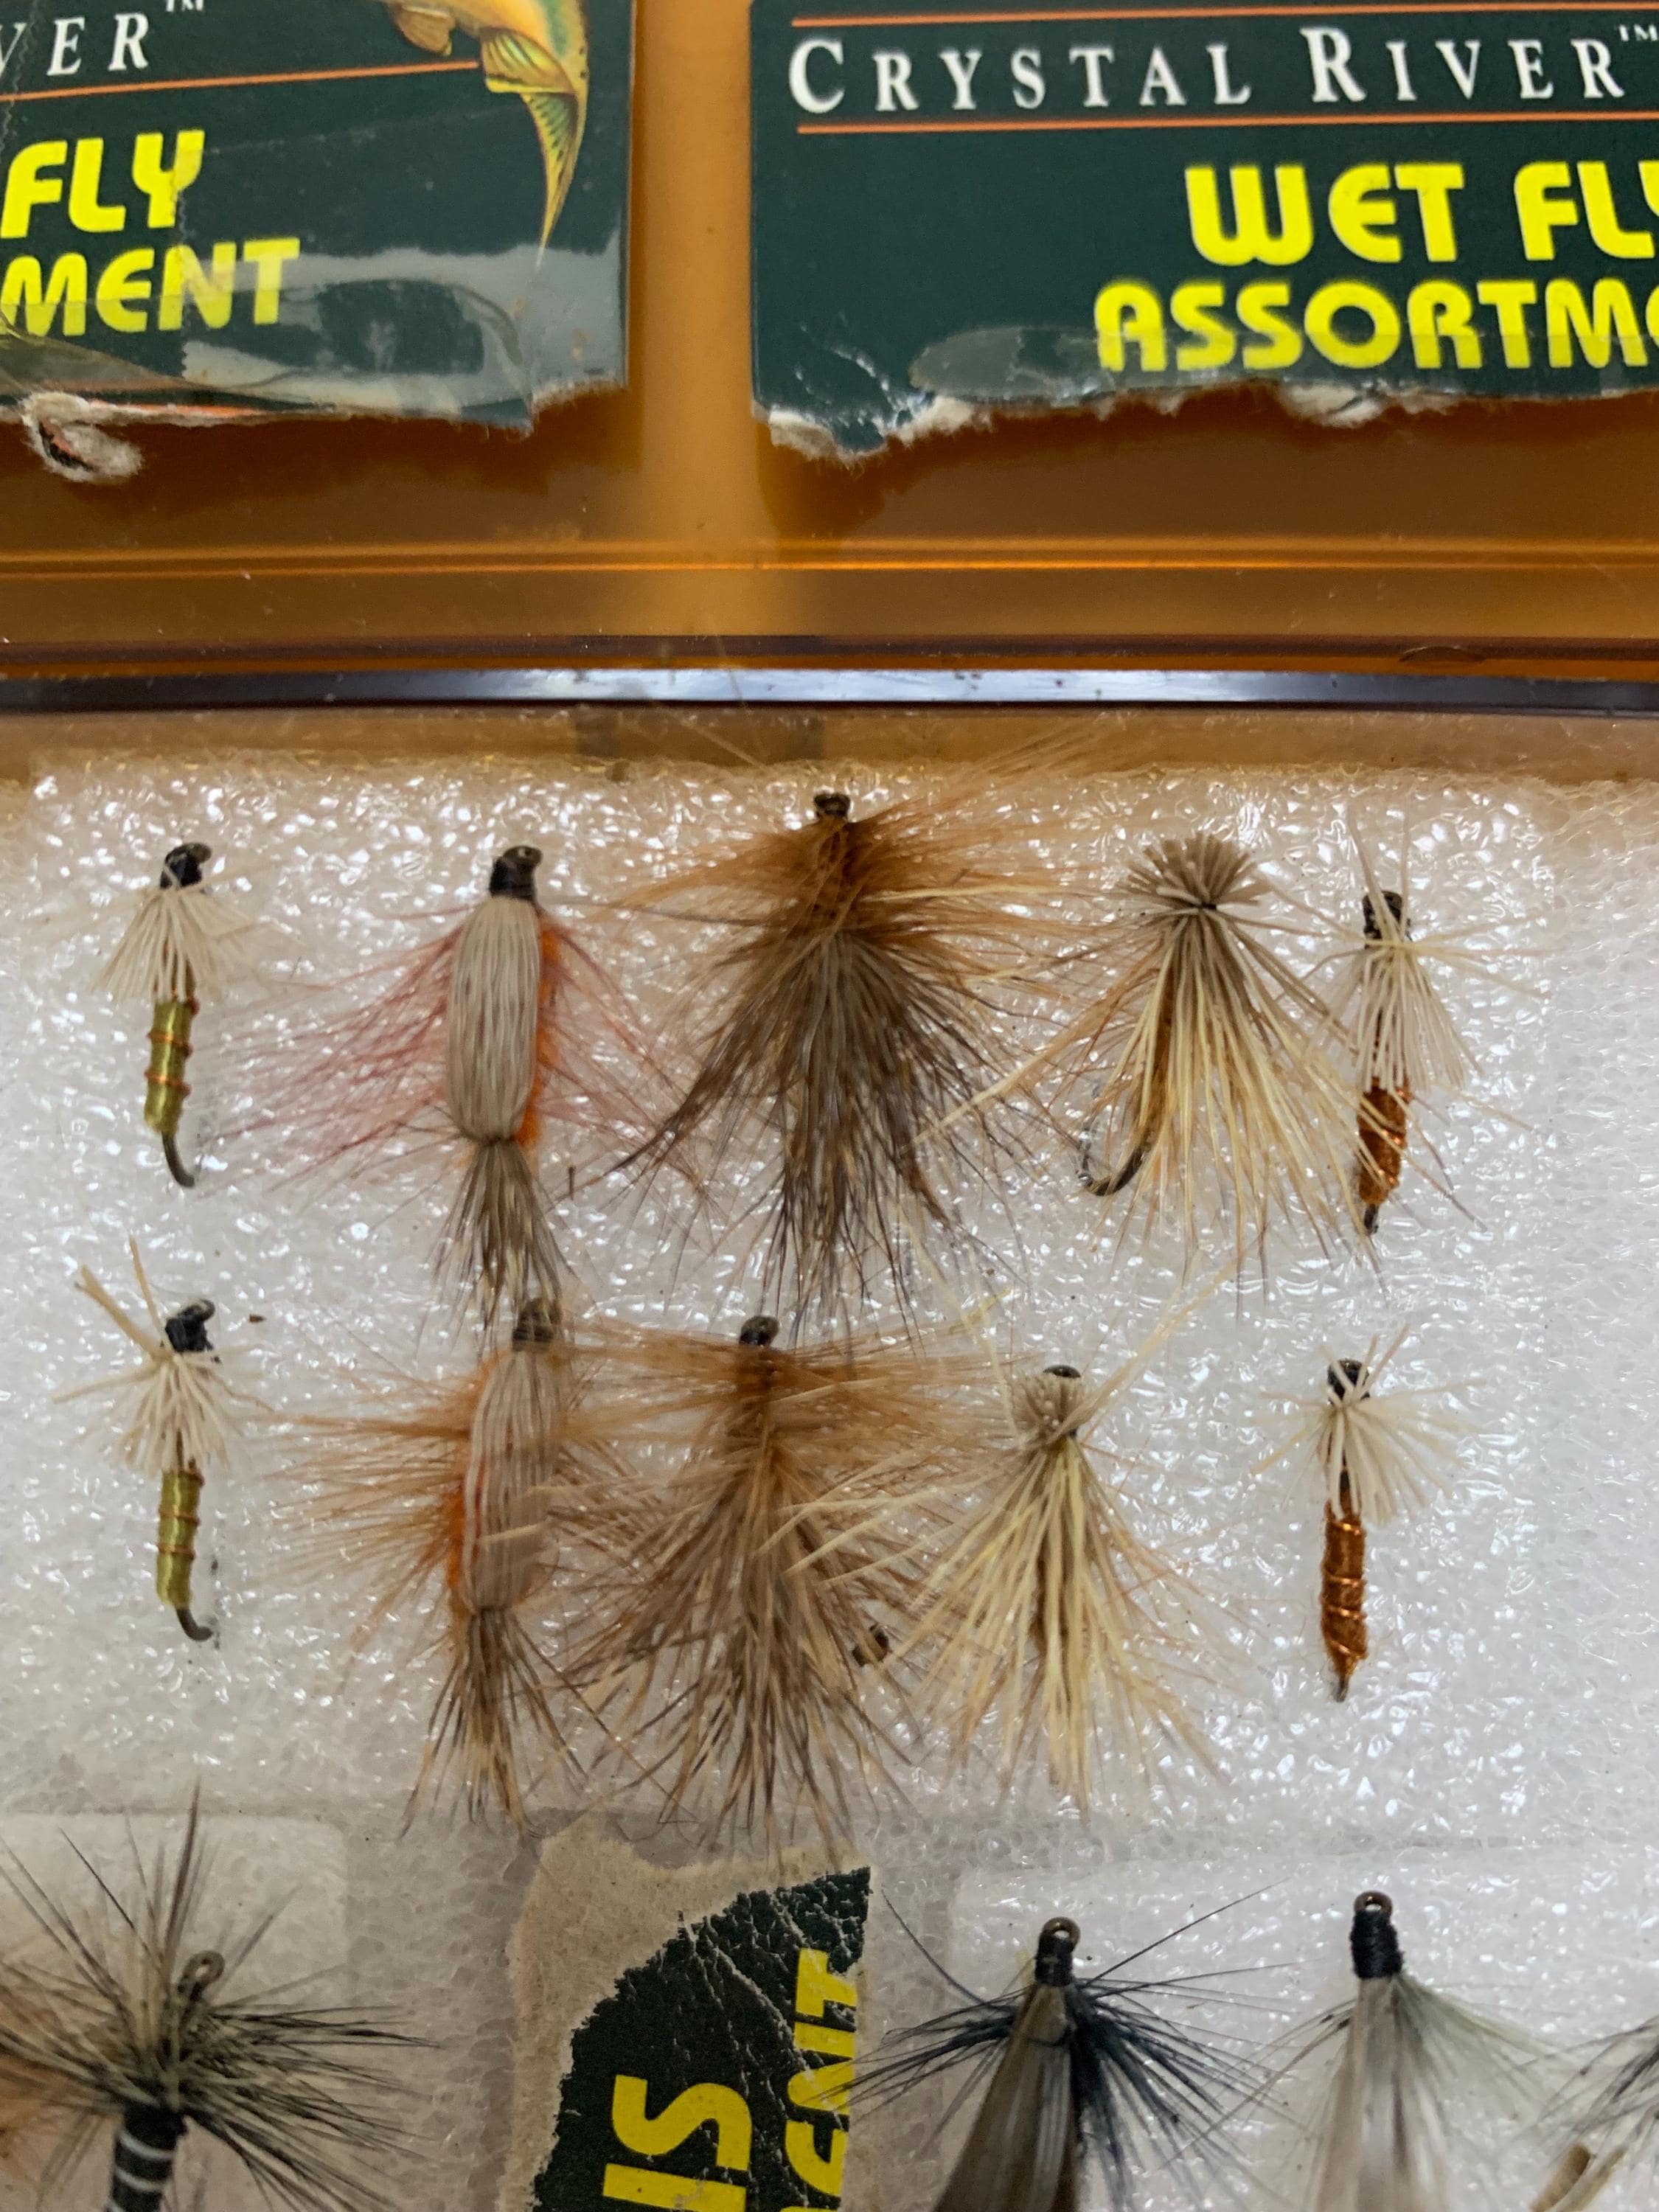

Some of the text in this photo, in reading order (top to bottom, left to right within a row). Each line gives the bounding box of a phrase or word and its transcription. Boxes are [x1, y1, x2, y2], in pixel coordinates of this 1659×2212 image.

[788, 38, 1251, 114] CRYSTAL
[1299, 26, 1625, 102] RIVER
[0, 128, 206, 240] FLY
[1185, 159, 1659, 266] WET FL
[0, 237, 301, 338] MENT
[1094, 277, 1659, 372] ASSORTM
